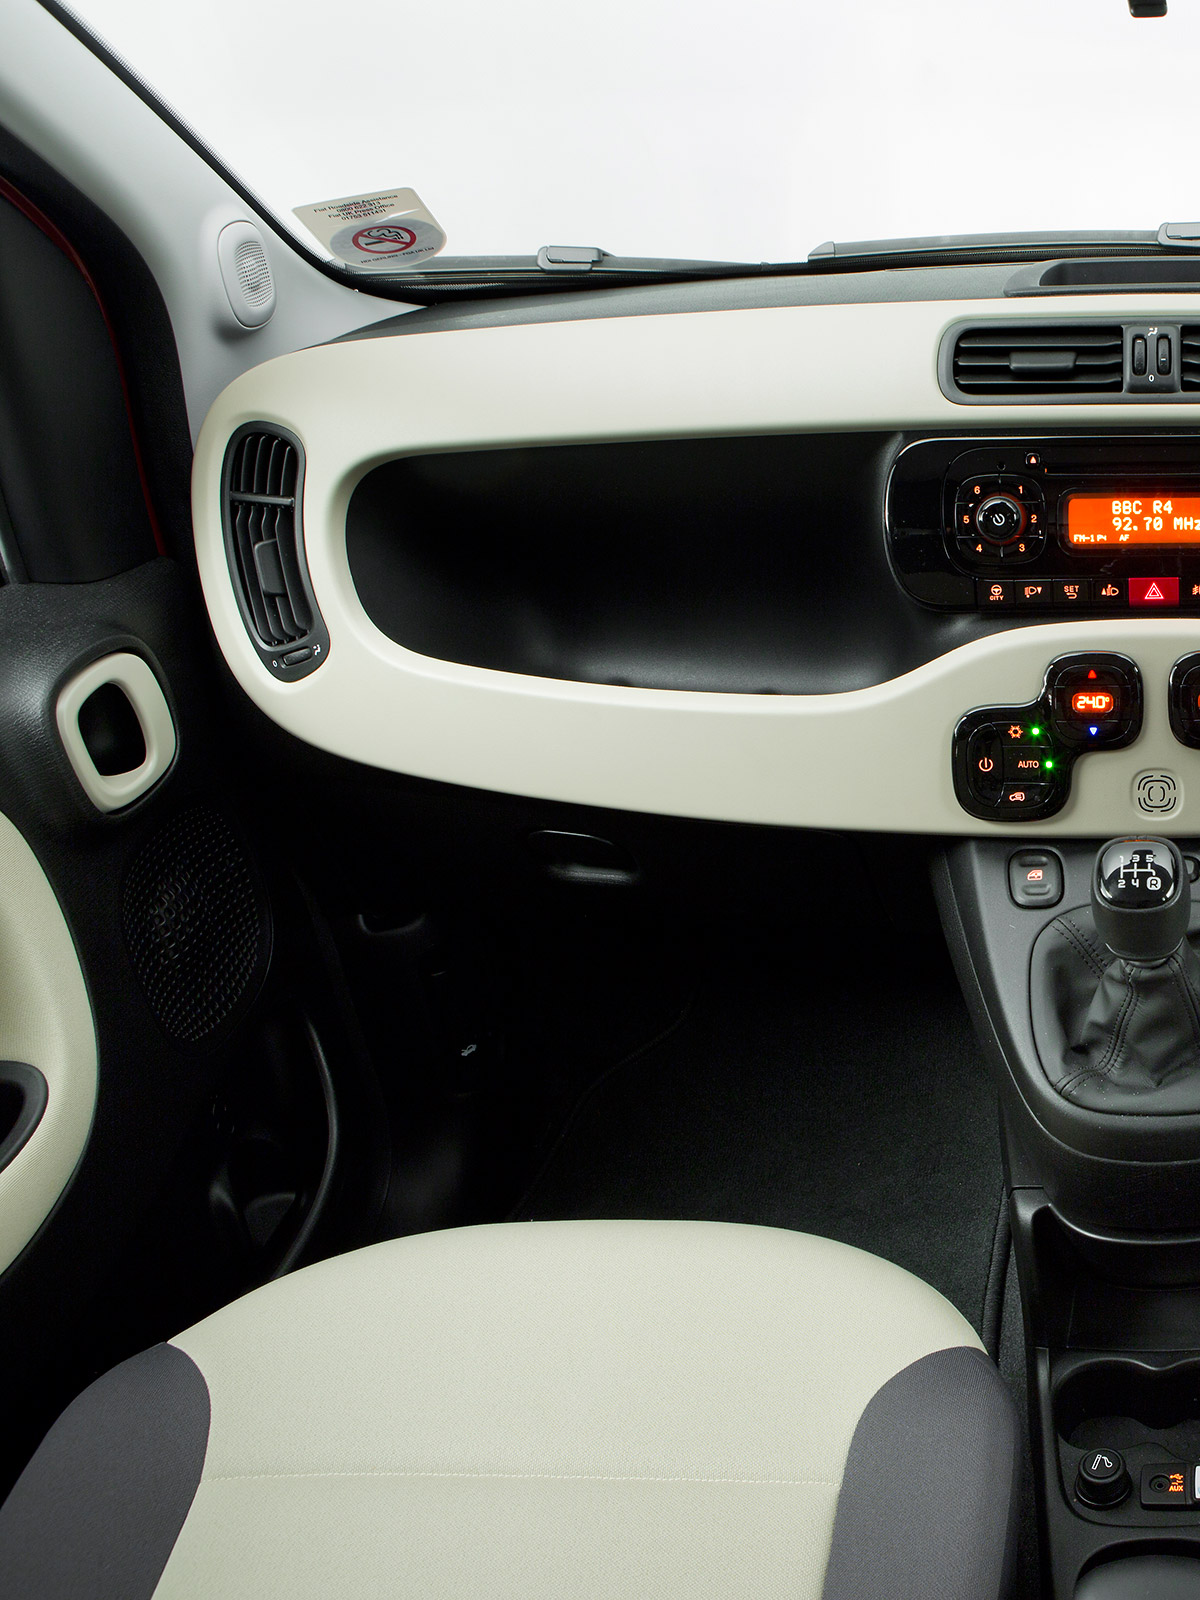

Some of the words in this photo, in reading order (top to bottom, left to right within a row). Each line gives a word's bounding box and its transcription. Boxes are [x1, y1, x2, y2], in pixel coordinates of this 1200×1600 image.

[361, 194, 398, 204] Assistance
[974, 485, 981, 494] 6
[1018, 485, 1023, 494] 1
[1112, 500, 1143, 515] BBC
[1152, 500, 1173, 514] R4
[963, 515, 970, 524] 5
[1030, 514, 1038, 523] 2
[1112, 516, 1163, 531] 92.70
[1119, 533, 1130, 542] AF
[975, 543, 983, 552] 4
[1018, 543, 1026, 552] 3
[1063, 585, 1080, 593] SET
[1017, 760, 1039, 769] AUTO
[1119, 855, 1124, 863] 1
[1132, 854, 1140, 863] 3
[1145, 854, 1154, 863] 5
[1117, 879, 1126, 889] 2
[1131, 878, 1139, 888] 4
[1150, 878, 1158, 888] R
